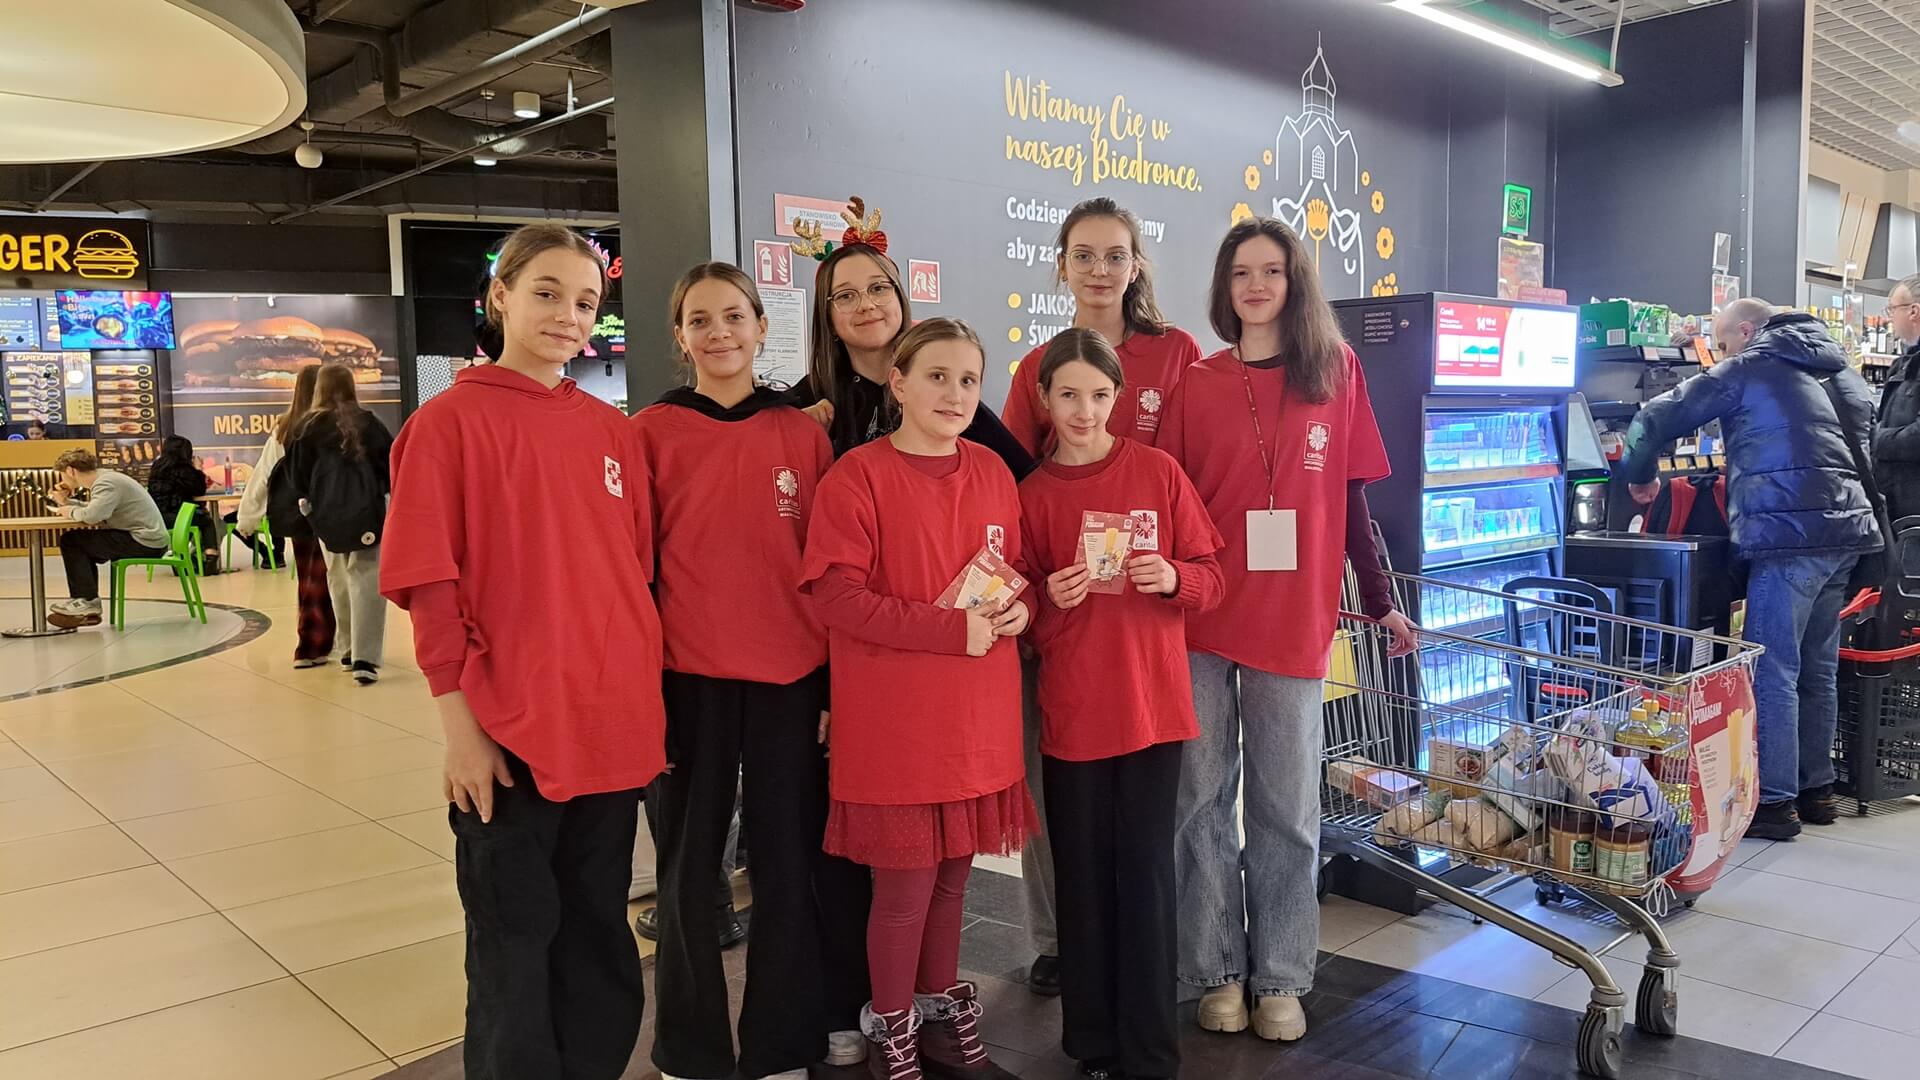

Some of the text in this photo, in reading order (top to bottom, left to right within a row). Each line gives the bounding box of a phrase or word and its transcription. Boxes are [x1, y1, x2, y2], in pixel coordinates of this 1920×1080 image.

[1005, 70, 1172, 144] Witamy Cię w
[1006, 135, 1202, 192] naszej Biedronce.
[1006, 196, 1071, 225] Codzien
[1509, 196, 1525, 219] S3
[0, 234, 72, 272] GER
[1007, 237, 1036, 267] aby
